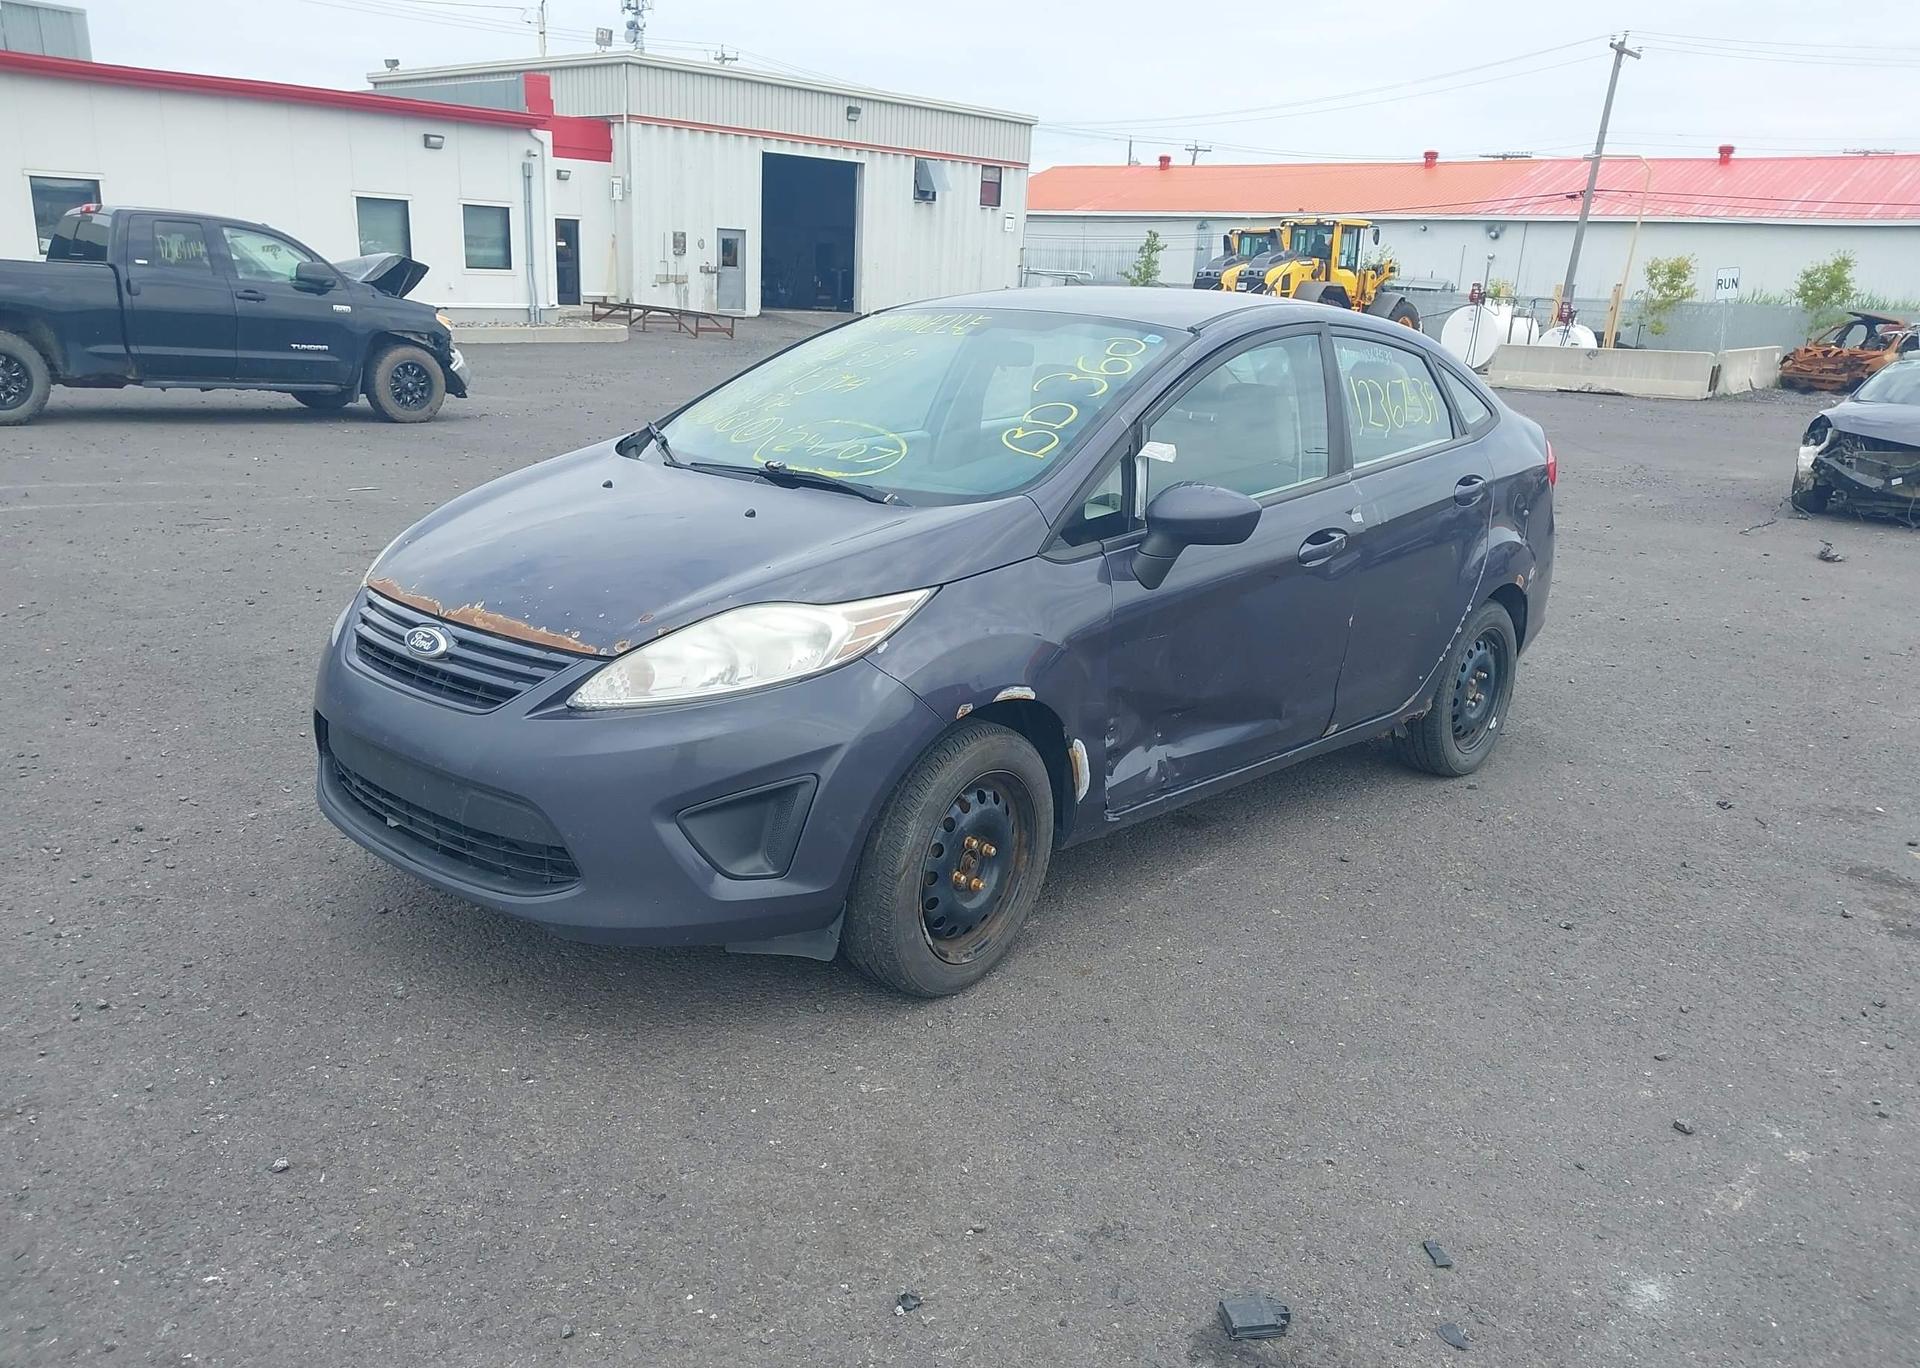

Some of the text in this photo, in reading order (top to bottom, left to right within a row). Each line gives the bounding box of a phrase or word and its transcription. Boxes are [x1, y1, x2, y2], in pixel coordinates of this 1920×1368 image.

[1716, 277, 1739, 290] RUN
[290, 343, 329, 351] TUNDRA
[1001, 336, 1146, 459] BD 360
[410, 631, 435, 651] Ford
